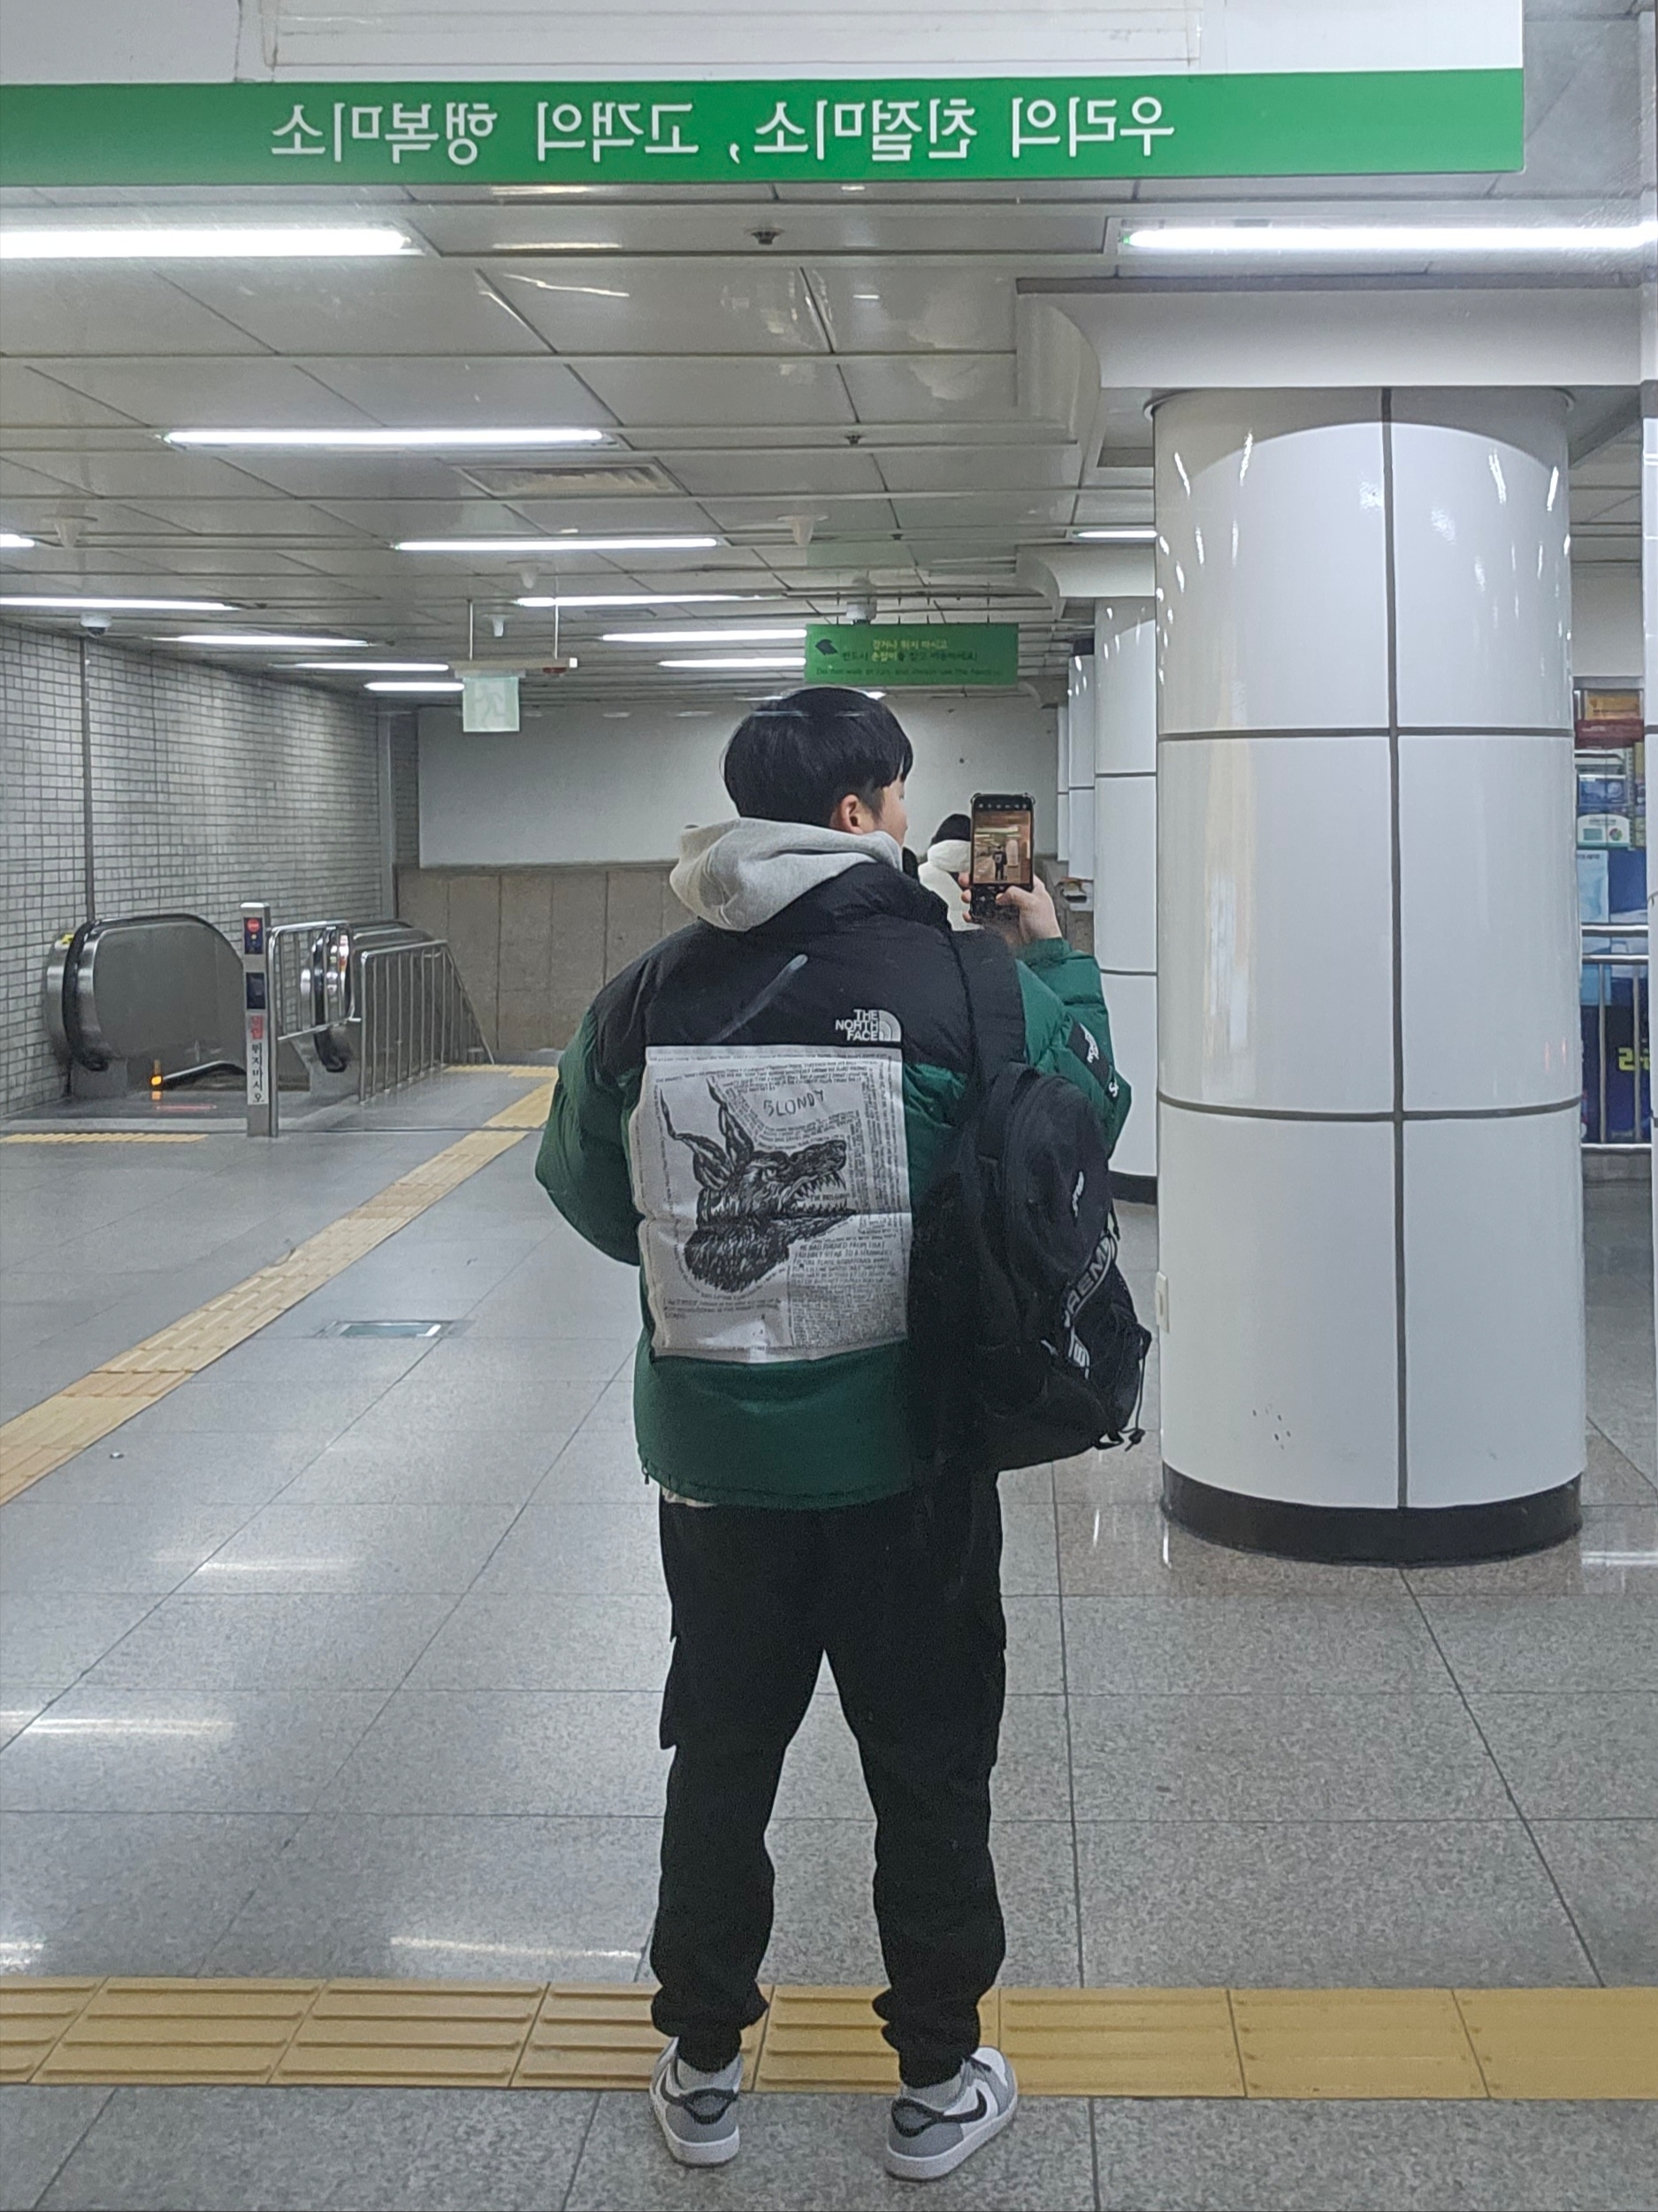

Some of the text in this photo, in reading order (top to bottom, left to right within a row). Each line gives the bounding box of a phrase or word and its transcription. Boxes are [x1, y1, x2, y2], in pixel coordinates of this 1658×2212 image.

[853, 1009, 878, 1021] THE
[835, 1019, 879, 1032] NORTH
[846, 1030, 878, 1041] FACE
[762, 1089, 825, 1118] BLONDY
